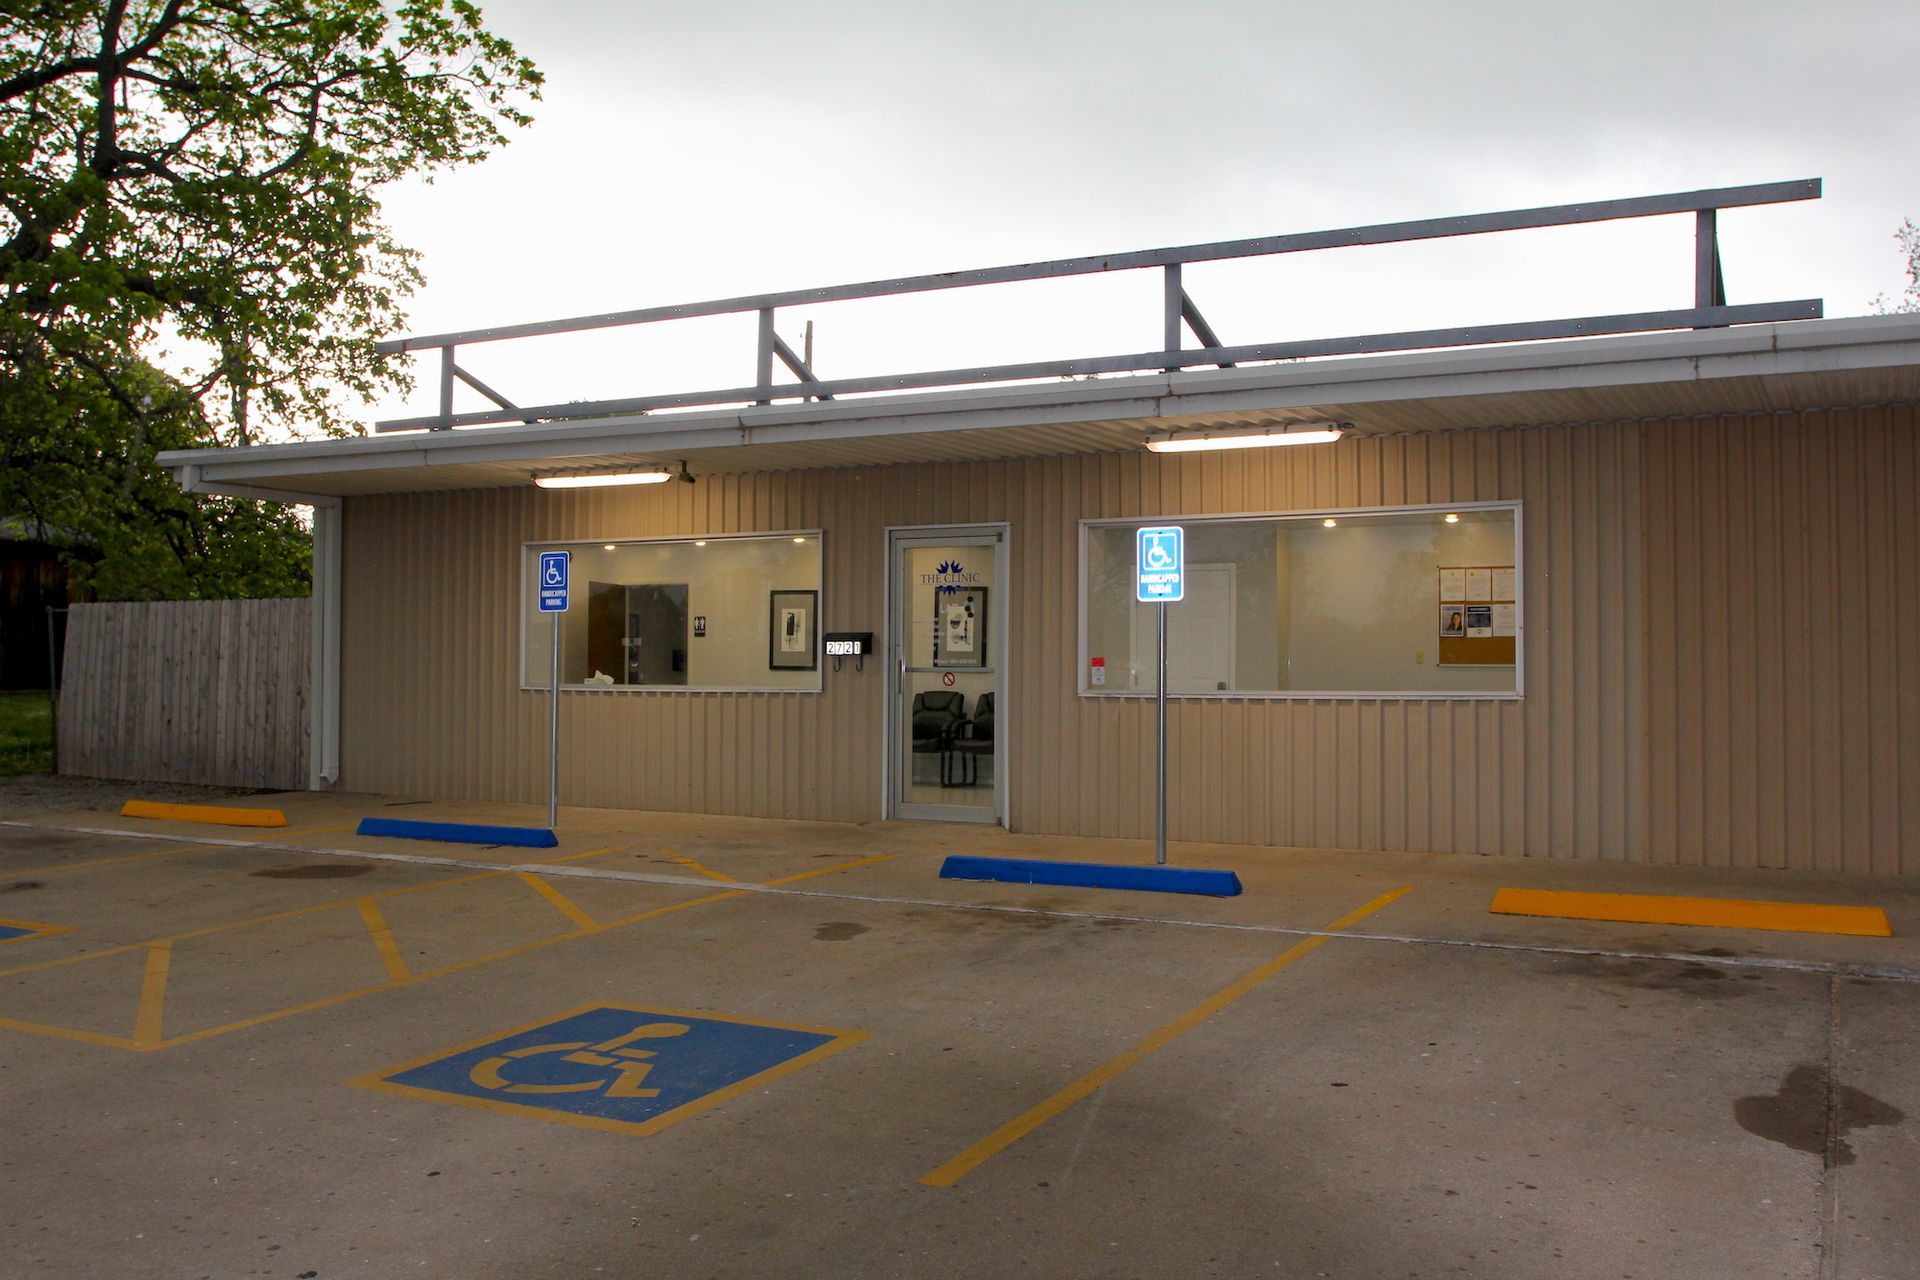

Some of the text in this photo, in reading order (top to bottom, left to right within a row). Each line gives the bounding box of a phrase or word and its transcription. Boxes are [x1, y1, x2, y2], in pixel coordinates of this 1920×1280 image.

[920, 572, 980, 584] THE CLINIC
[1147, 584, 1173, 594] PARKING
[545, 598, 562, 606] PARKING
[827, 642, 860, 654] 2721
